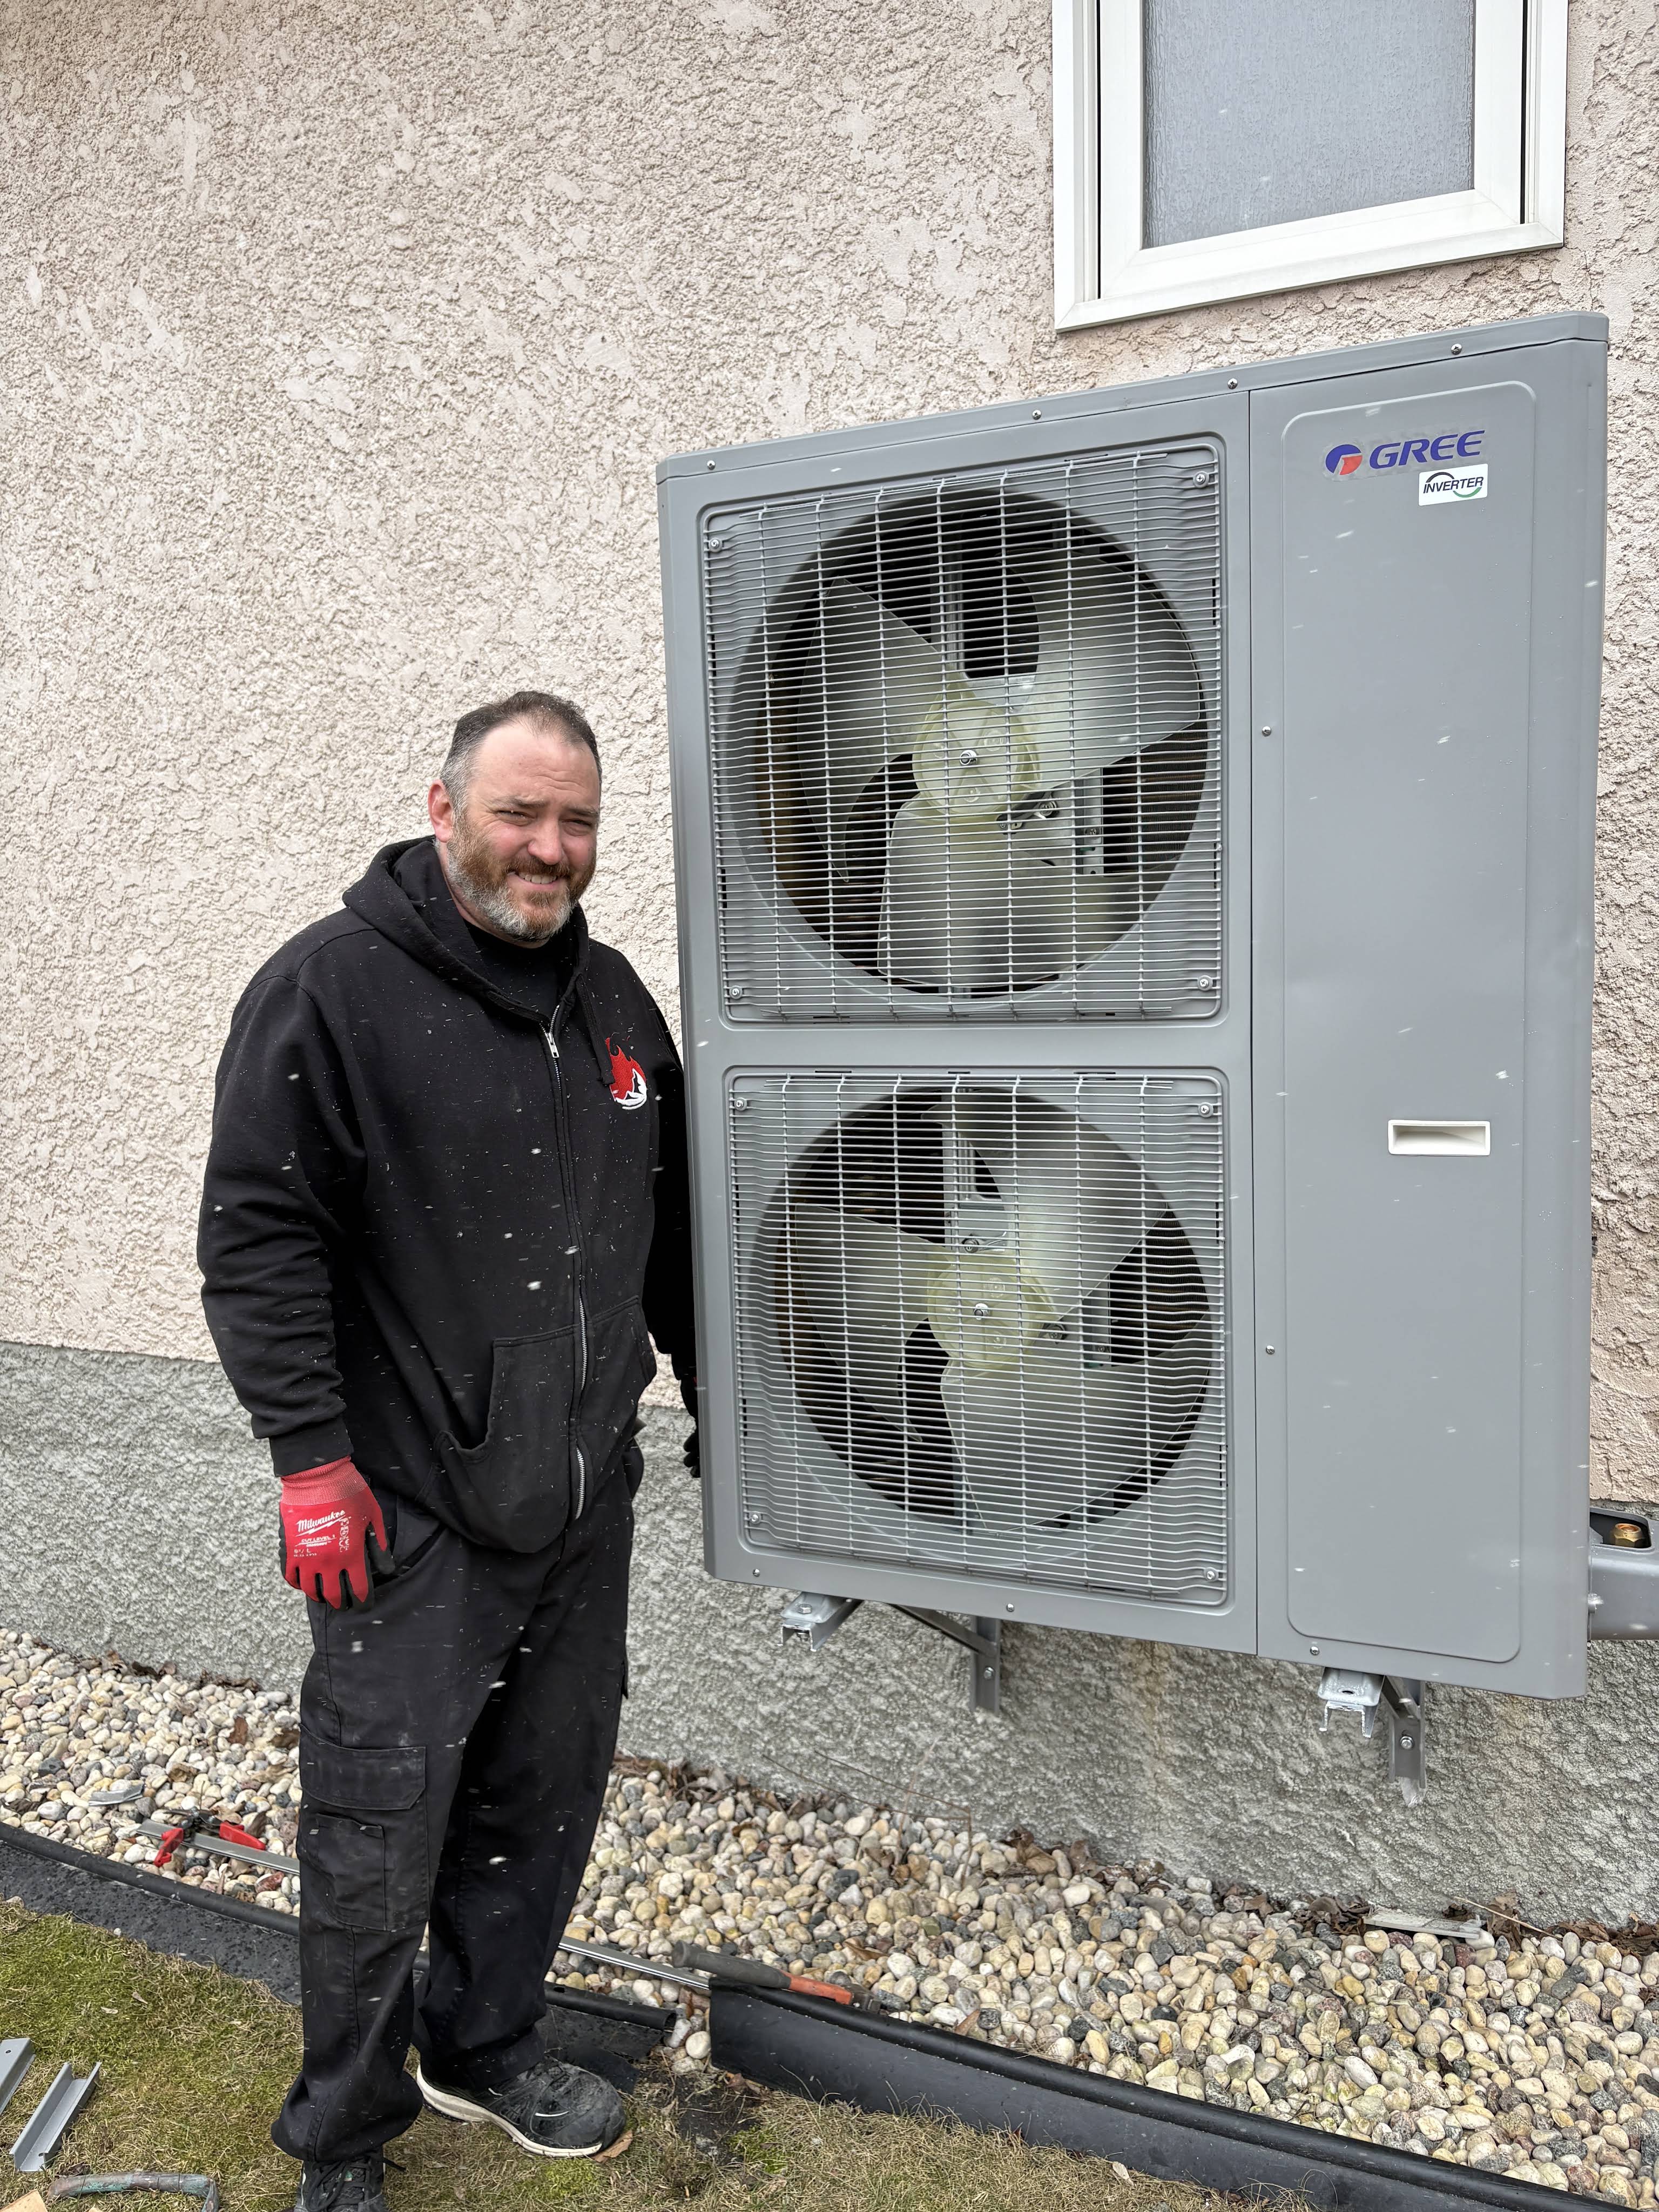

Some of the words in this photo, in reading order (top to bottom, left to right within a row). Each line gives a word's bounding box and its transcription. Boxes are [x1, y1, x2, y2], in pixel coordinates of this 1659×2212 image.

[1369, 430, 1485, 469] GREE
[1423, 476, 1484, 494] INVERTER
[295, 1510, 346, 1532] Milwaukee
